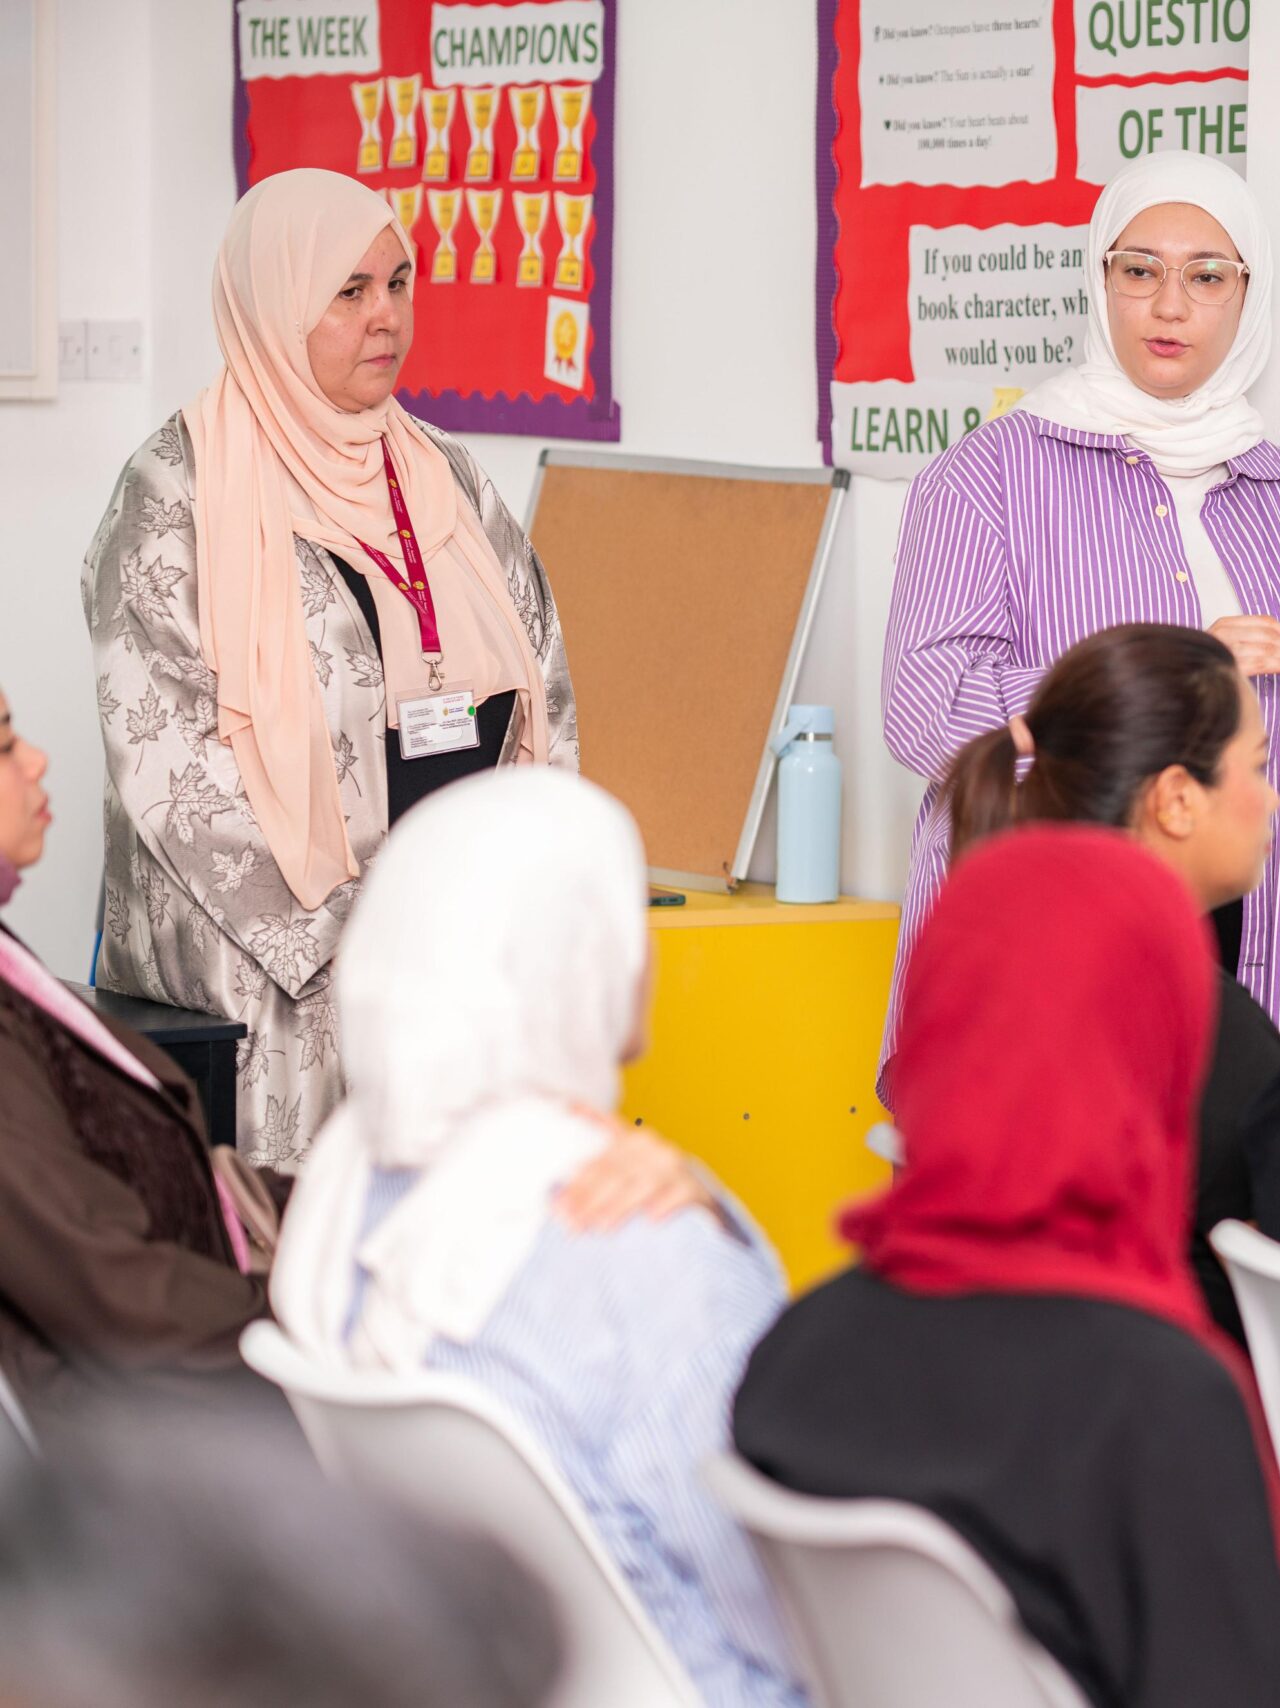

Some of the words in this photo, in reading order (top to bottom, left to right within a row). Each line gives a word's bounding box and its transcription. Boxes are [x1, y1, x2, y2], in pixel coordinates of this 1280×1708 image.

[248, 17, 290, 58] THE
[298, 15, 367, 57] WEEK
[434, 22, 598, 68] CHAMPIONS
[1089, 0, 1250, 57] QUESTIO
[1119, 108, 1163, 159] OF
[1174, 104, 1247, 154] THE
[924, 248, 938, 275] If
[942, 253, 972, 281] you
[978, 244, 1026, 272] could
[1033, 243, 1055, 269] be
[1061, 248, 1086, 275] an
[918, 294, 959, 320] book
[964, 292, 1056, 321] character,
[1062, 288, 1088, 315] wh
[945, 338, 997, 366] would
[1003, 344, 1036, 372] you
[1042, 335, 1073, 364] be?
[851, 406, 948, 453] LEARN
